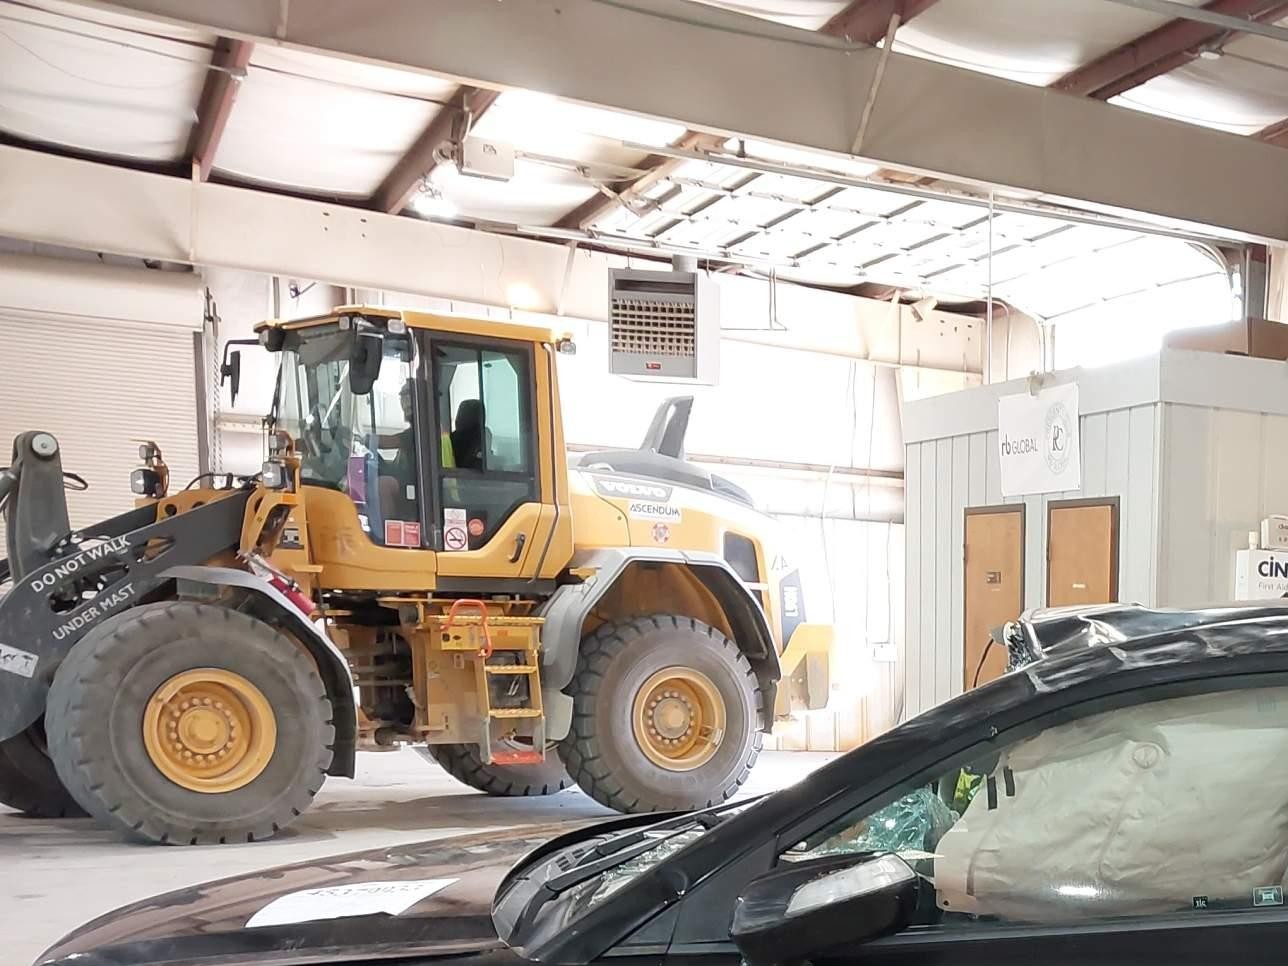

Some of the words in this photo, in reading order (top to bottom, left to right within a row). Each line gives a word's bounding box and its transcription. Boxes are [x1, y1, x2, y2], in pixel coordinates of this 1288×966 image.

[1012, 437, 1038, 455] GLOBAL
[630, 504, 680, 516] ASCENDUM
[31, 573, 55, 592] DO
[54, 554, 86, 579] NOT
[86, 535, 131, 560] WALK
[1258, 582, 1274, 591] First
[1276, 582, 1288, 591] Aid
[52, 607, 101, 640] UNDER
[99, 583, 135, 611] MAST
